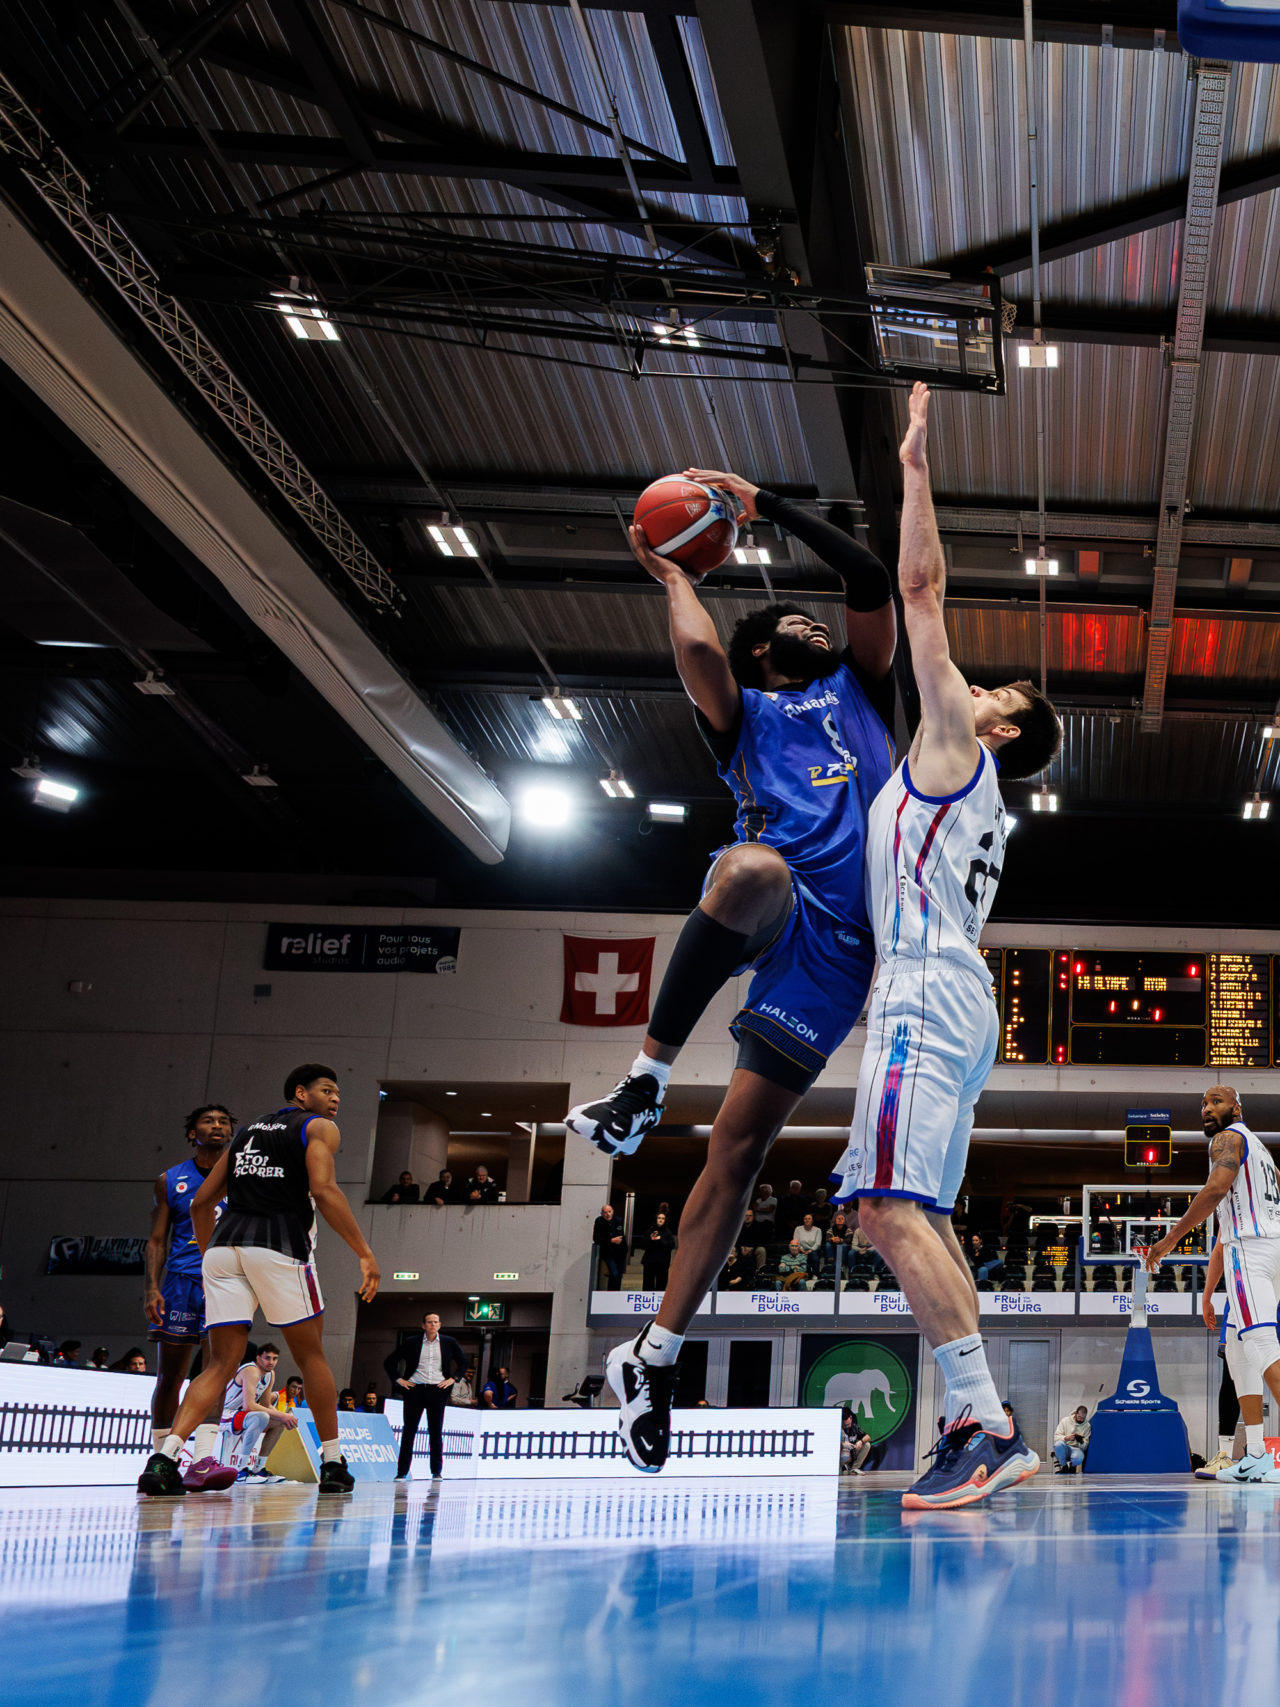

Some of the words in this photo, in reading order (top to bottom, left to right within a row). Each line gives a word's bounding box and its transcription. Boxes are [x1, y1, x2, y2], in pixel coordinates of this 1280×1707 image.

[280, 933, 351, 955] relief
[759, 1003, 819, 1042] HALEON
[633, 1303, 659, 1312] BOU
[881, 1304, 912, 1313] BOUR
